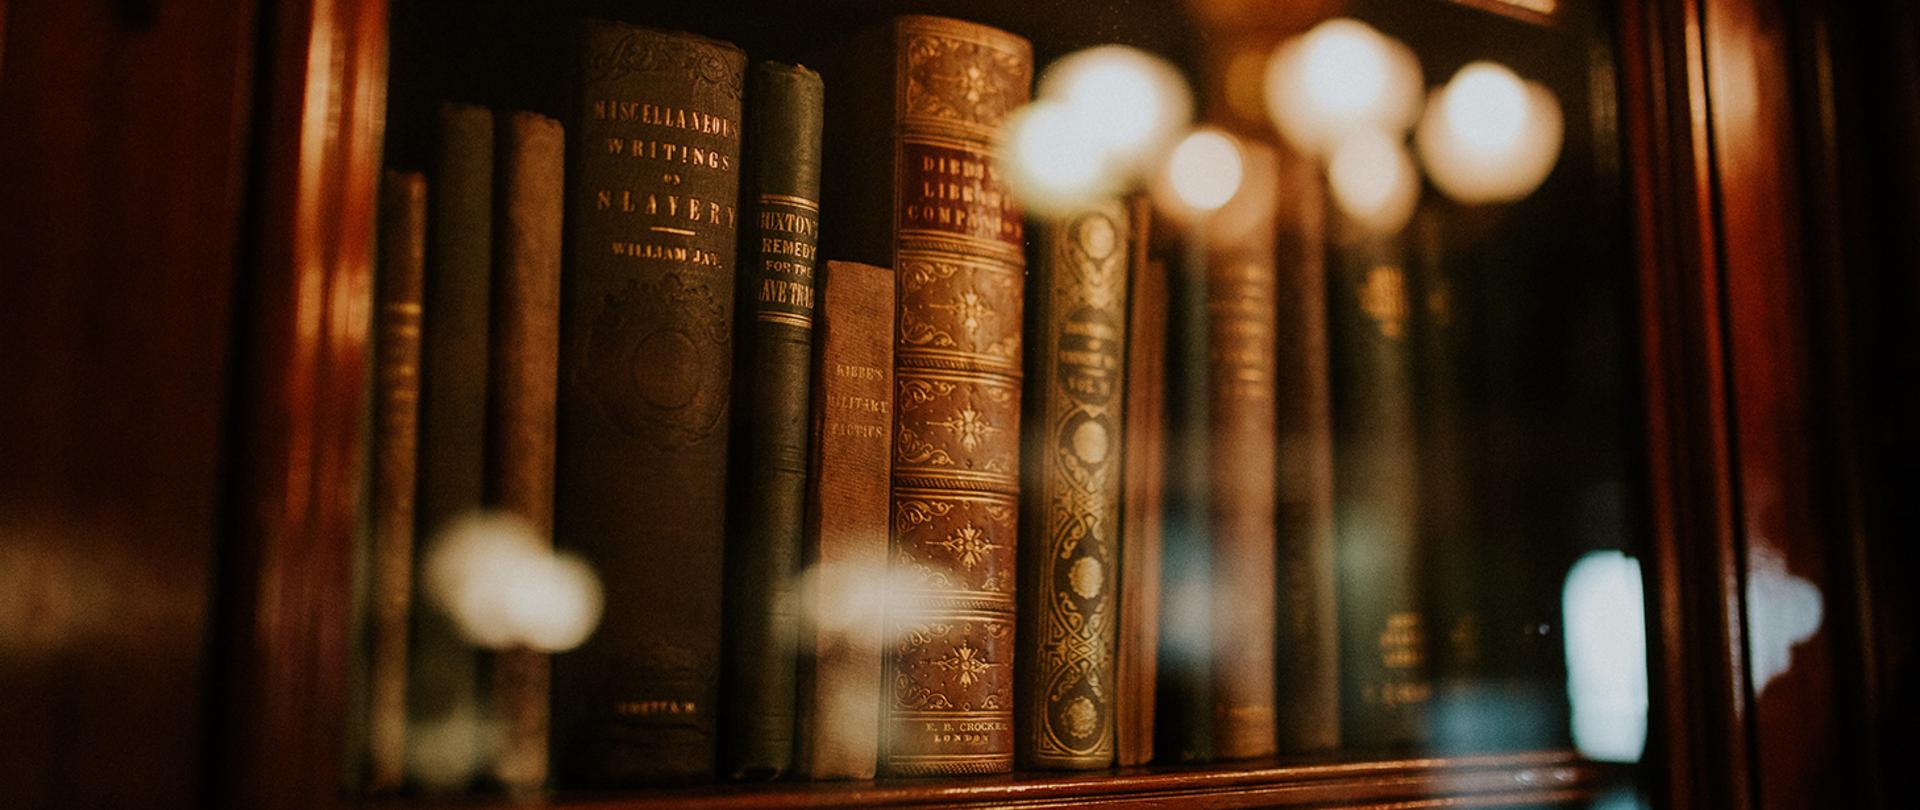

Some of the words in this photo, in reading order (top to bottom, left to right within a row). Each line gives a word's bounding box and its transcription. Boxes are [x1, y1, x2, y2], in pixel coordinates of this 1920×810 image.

[596, 101, 737, 139] MISCELLANEOUS
[607, 138, 730, 172] WRITINGS
[663, 173, 681, 186] ON
[595, 191, 737, 230] SLAVERY
[612, 241, 687, 263] WILLIAM
[762, 238, 817, 261] REMEDY
[766, 260, 791, 273] FOR
[794, 263, 813, 279] THE
[934, 734, 990, 744] LONDON
